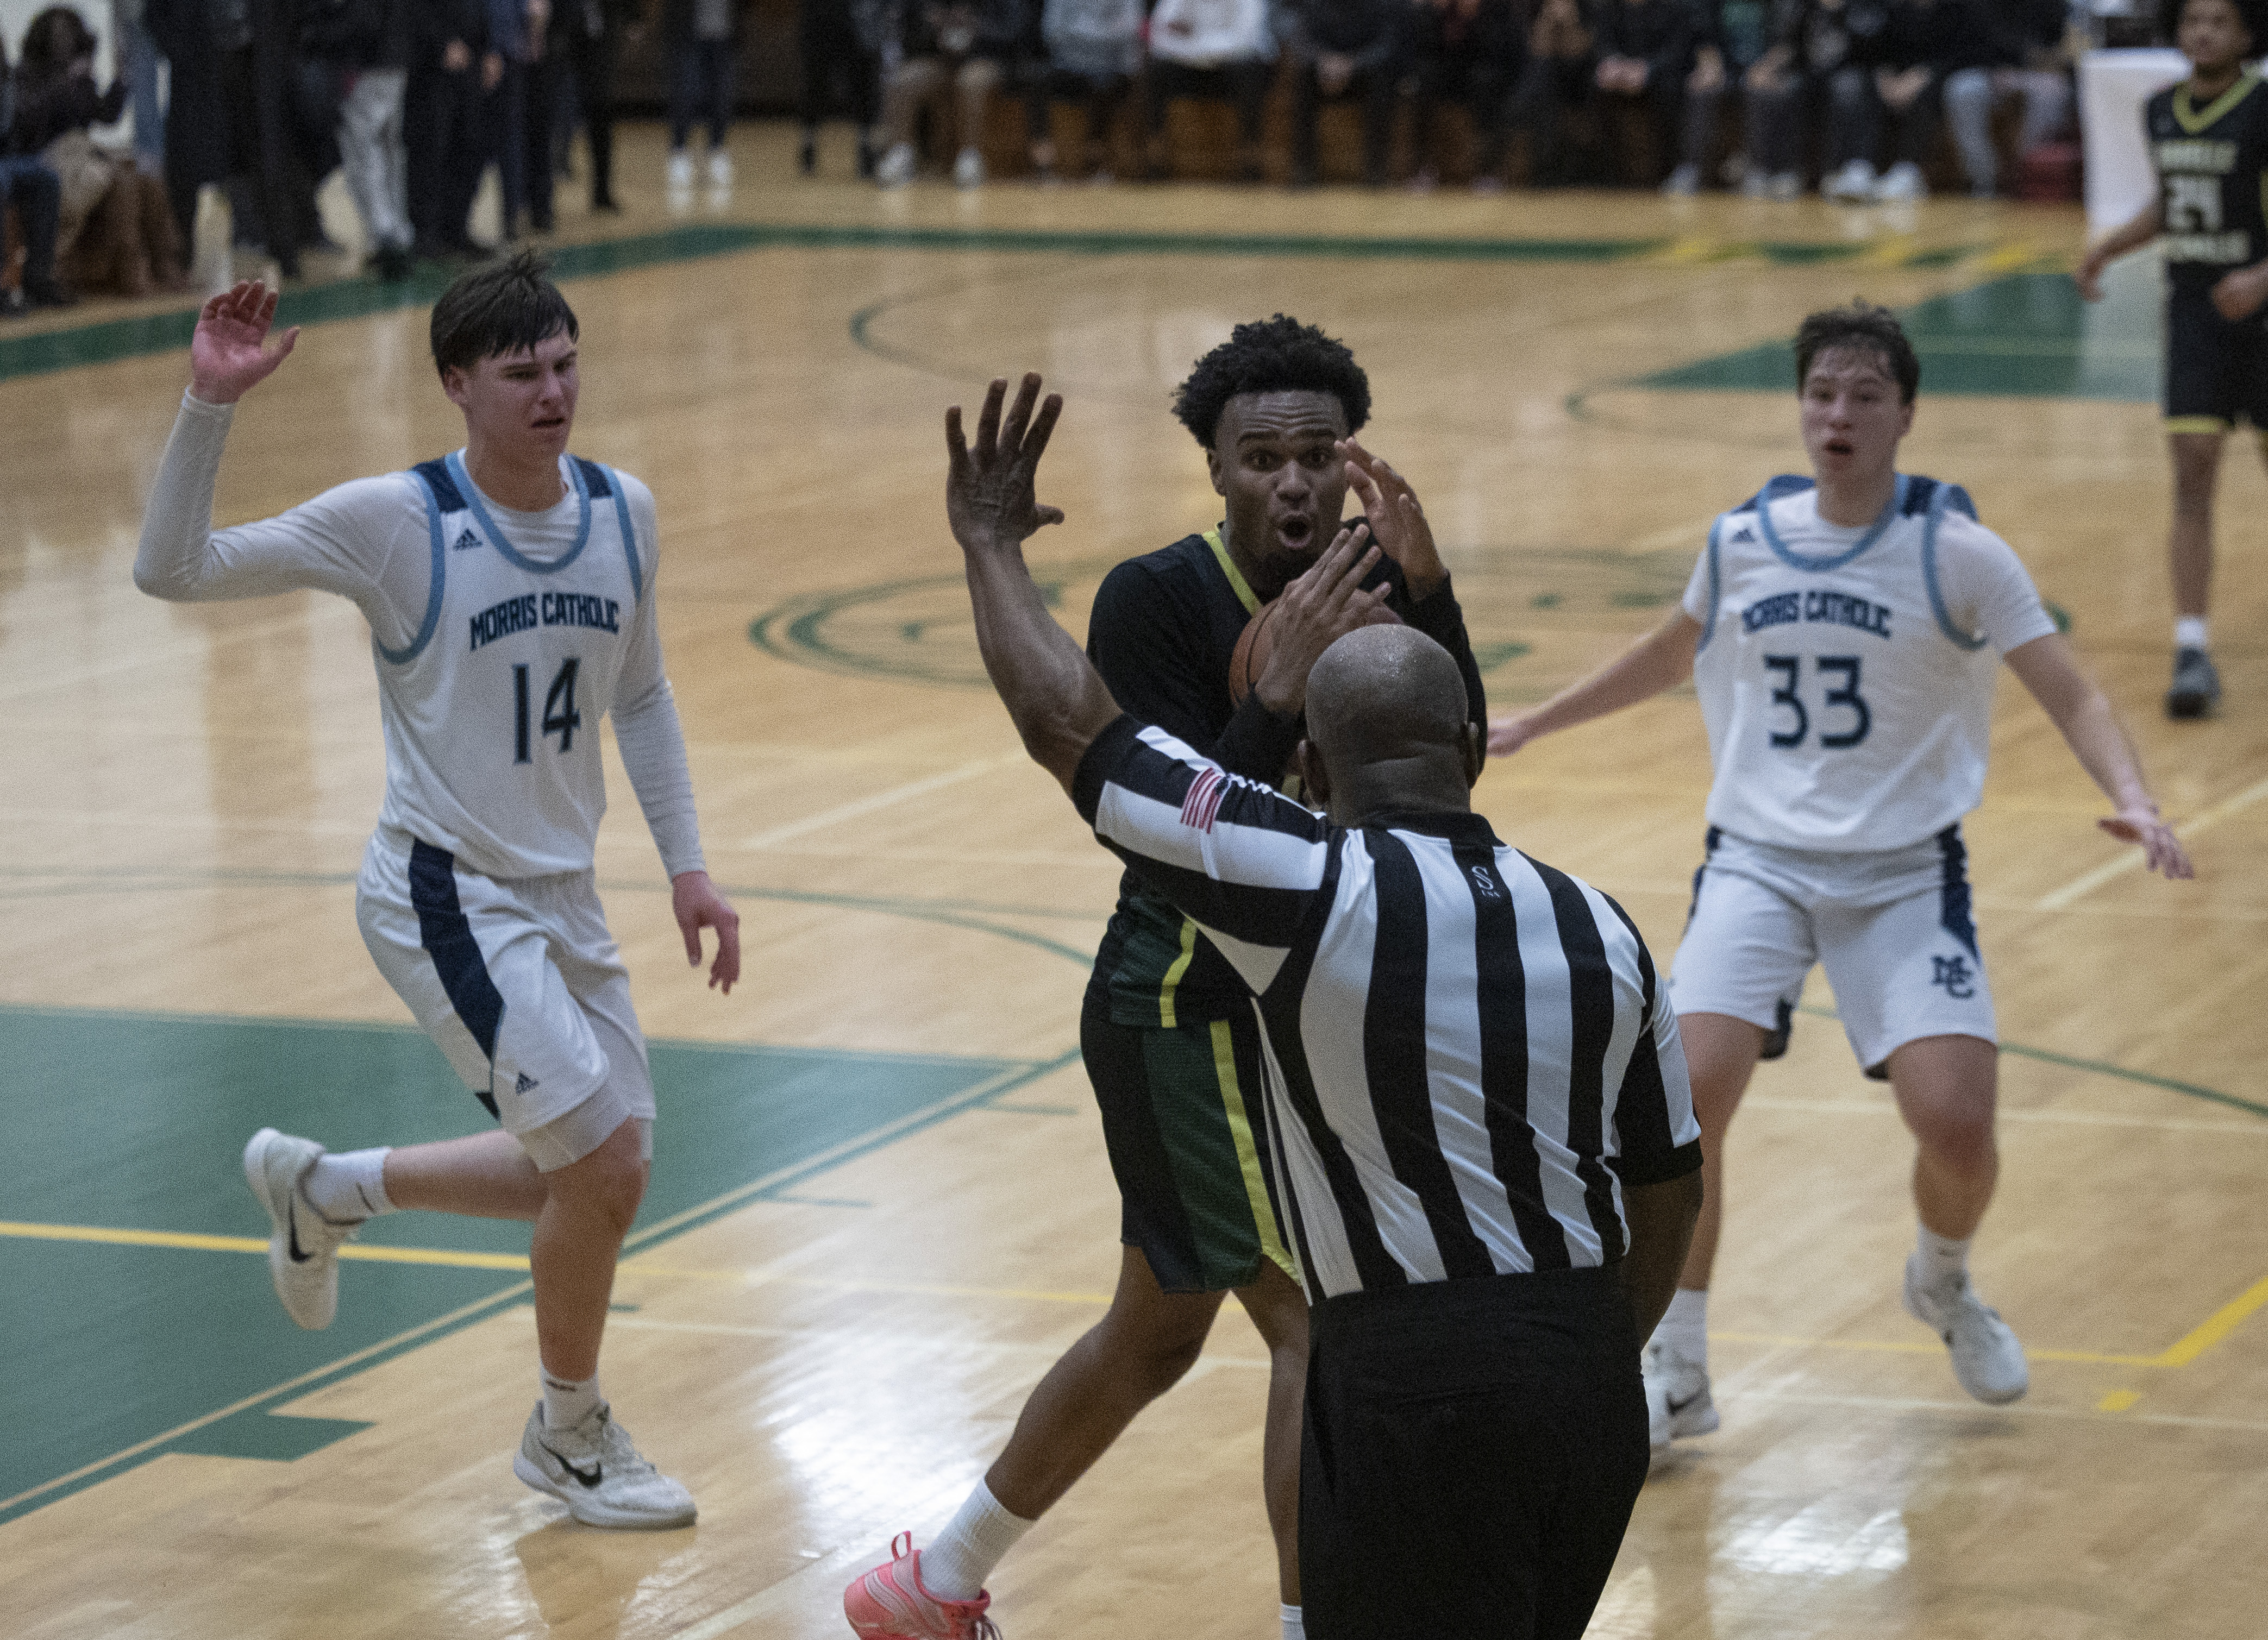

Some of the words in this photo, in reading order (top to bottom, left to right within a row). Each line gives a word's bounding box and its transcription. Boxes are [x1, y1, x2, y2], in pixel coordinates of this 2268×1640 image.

[469, 593, 538, 651] MORRIS
[541, 592, 619, 634] CATHOLIC
[512, 656, 581, 764] 14
[1764, 654, 1872, 750] 33
